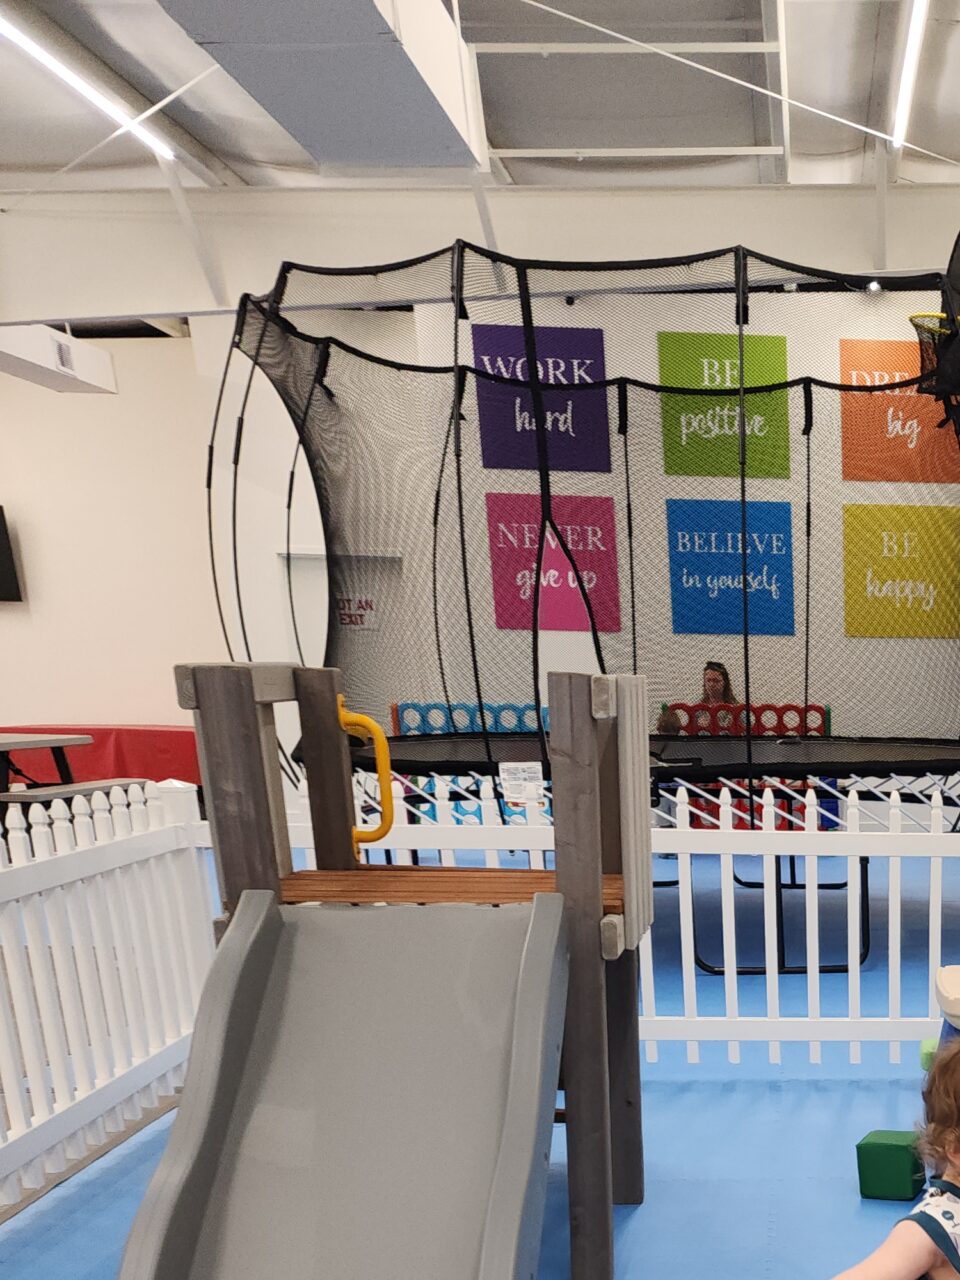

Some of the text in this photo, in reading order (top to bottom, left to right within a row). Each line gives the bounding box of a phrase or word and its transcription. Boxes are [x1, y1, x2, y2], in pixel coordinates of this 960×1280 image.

[480, 355, 595, 386] WORK
[700, 358, 741, 388] BE
[680, 403, 769, 446] positive
[886, 407, 921, 449] big
[497, 523, 607, 551] NEVER
[676, 531, 786, 555] BELIEVE
[880, 531, 920, 558] BE
[515, 562, 598, 600] give up
[682, 564, 780, 600] in yourself
[865, 565, 938, 612] happy
[339, 613, 366, 626] EXIT
[356, 598, 375, 611] AN
